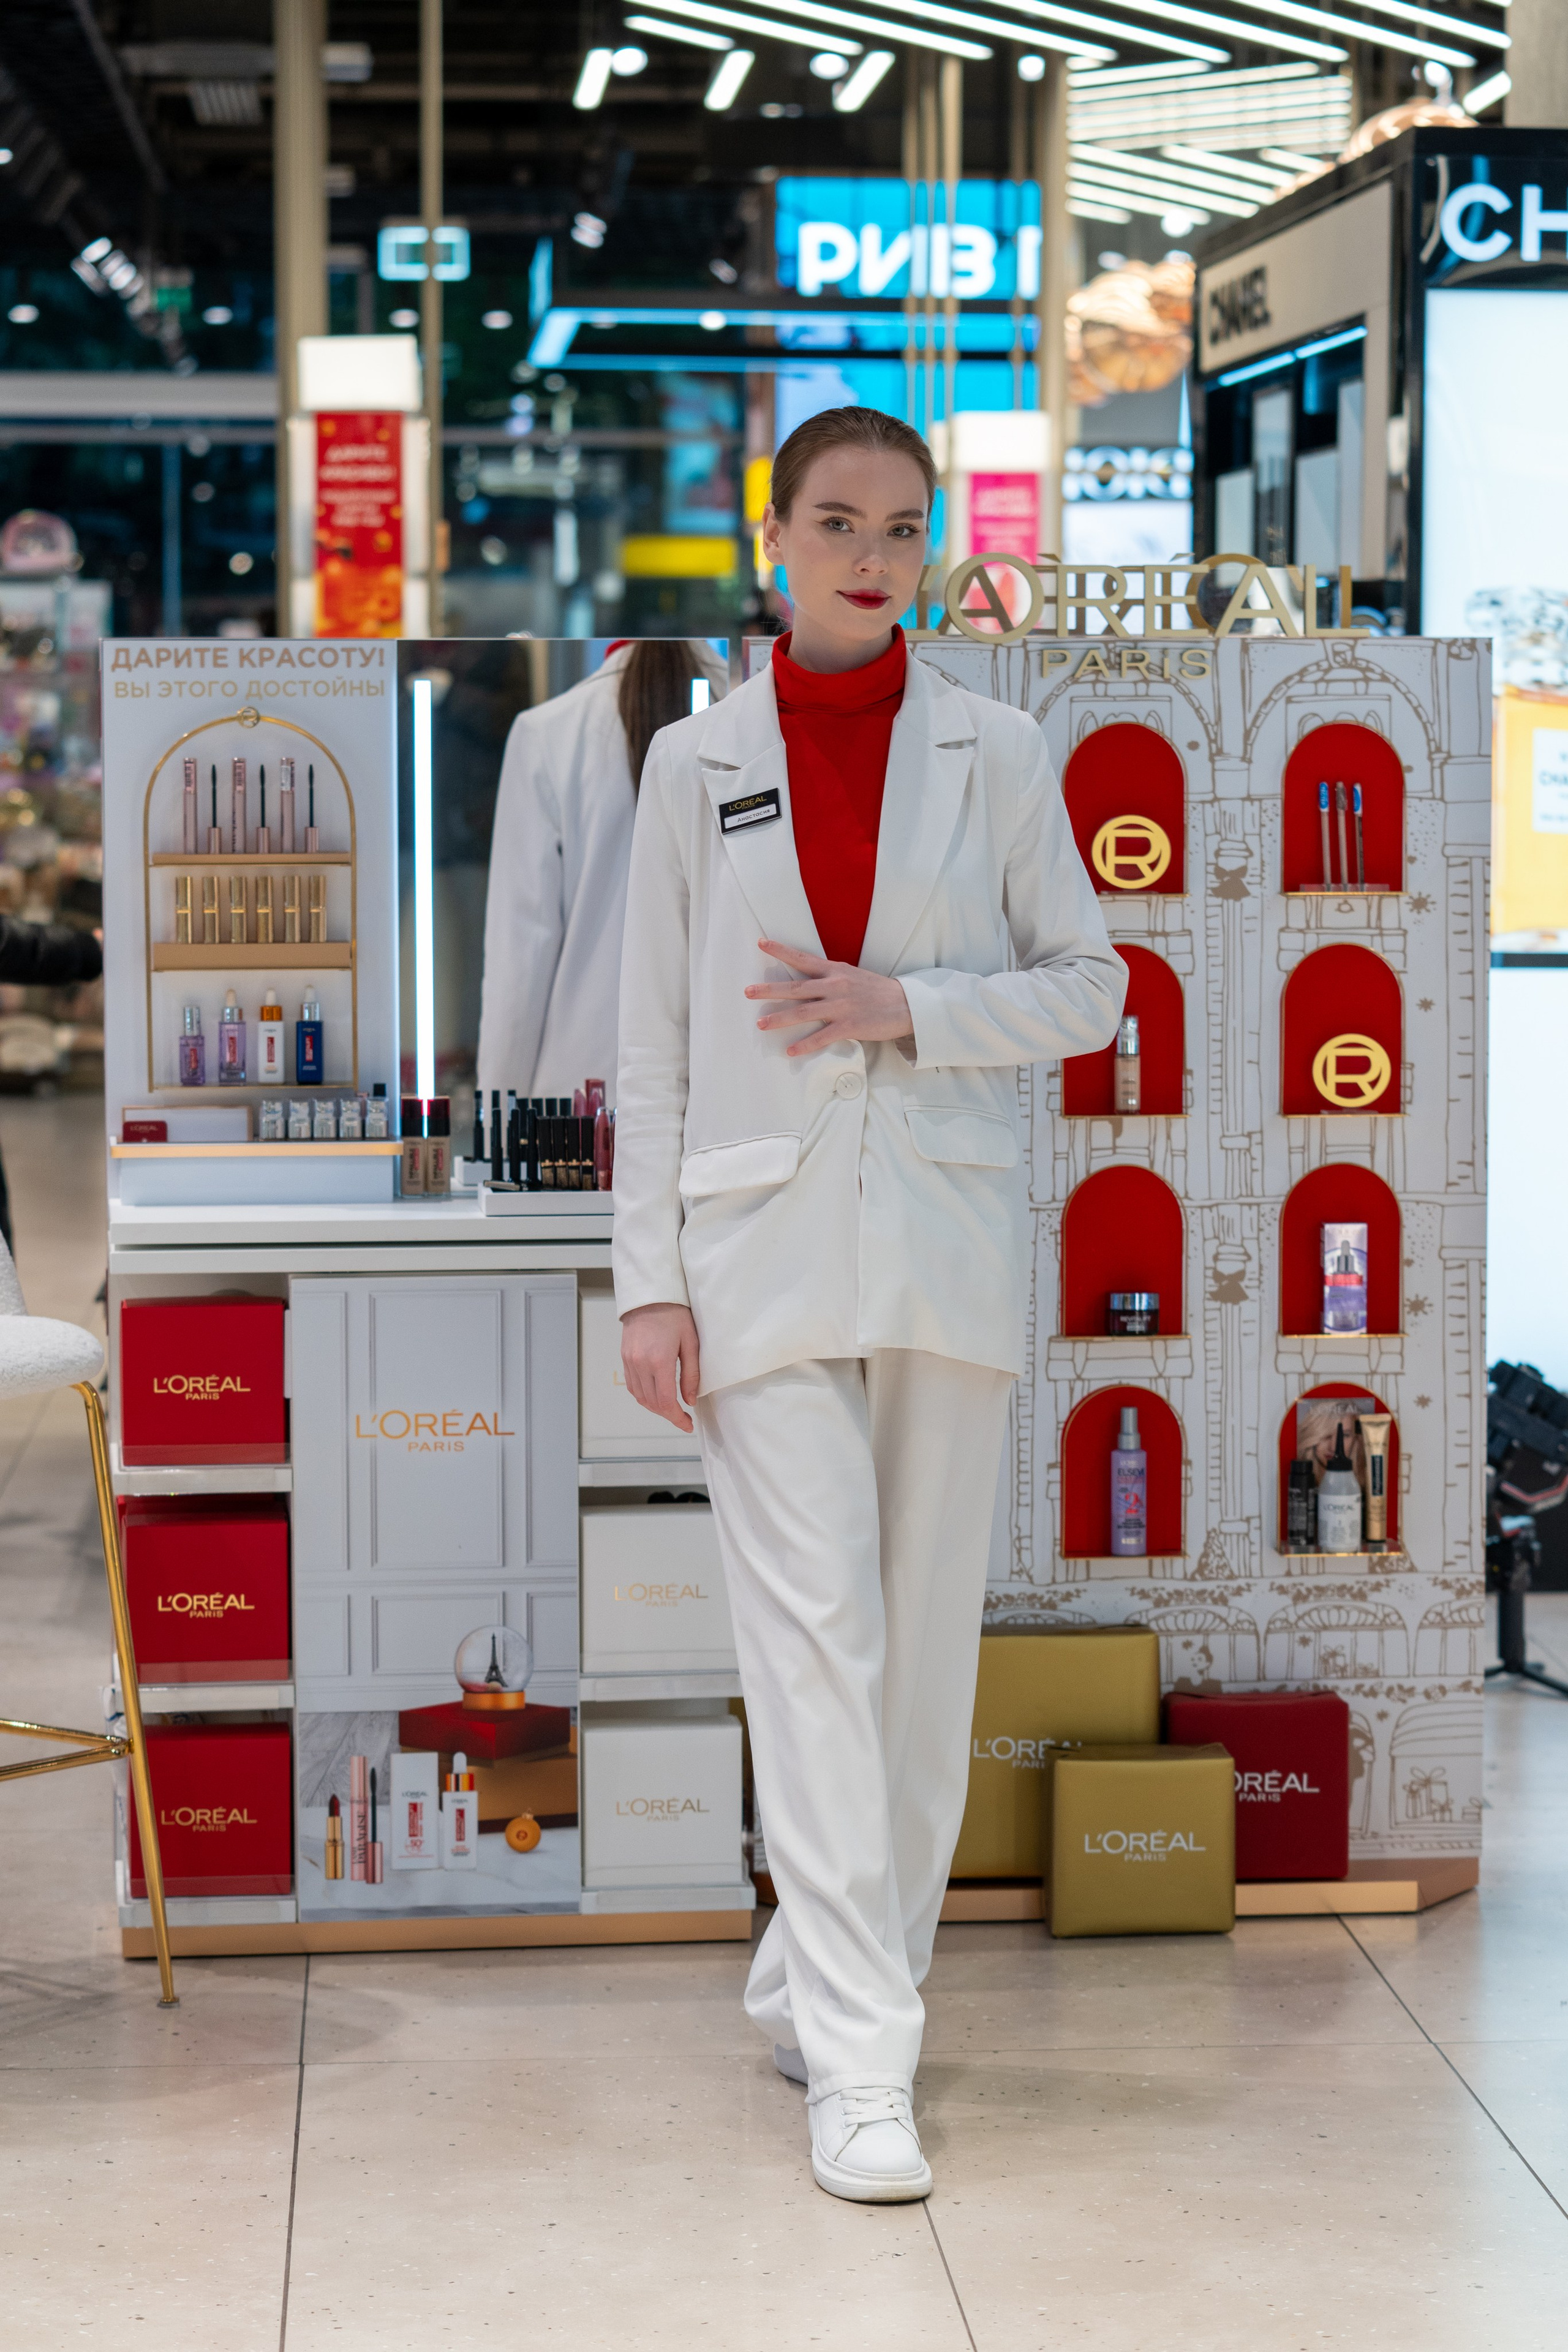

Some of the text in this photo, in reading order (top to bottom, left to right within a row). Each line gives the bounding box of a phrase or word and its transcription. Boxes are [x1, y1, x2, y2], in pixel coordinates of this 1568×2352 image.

[798, 222, 998, 299] РИВ
[111, 647, 385, 672] ДАРИТЕ КРАСОТУ!
[114, 676, 385, 700] ВЫ ЭТОГО ДОСТОЙНЫ
[737, 809, 771, 823] Анастасия
[154, 1374, 251, 1394] L'ORÉAL
[355, 1409, 515, 1439] L'ORÉAL
[157, 1592, 255, 1612] L'ORÉAL
[614, 1583, 709, 1601] L'ORÉAL
[161, 1806, 257, 1825] L'ORÉAL
[616, 1797, 709, 1816] L'ORÉAL
[1084, 1830, 1205, 1853] L'ORÉAL
